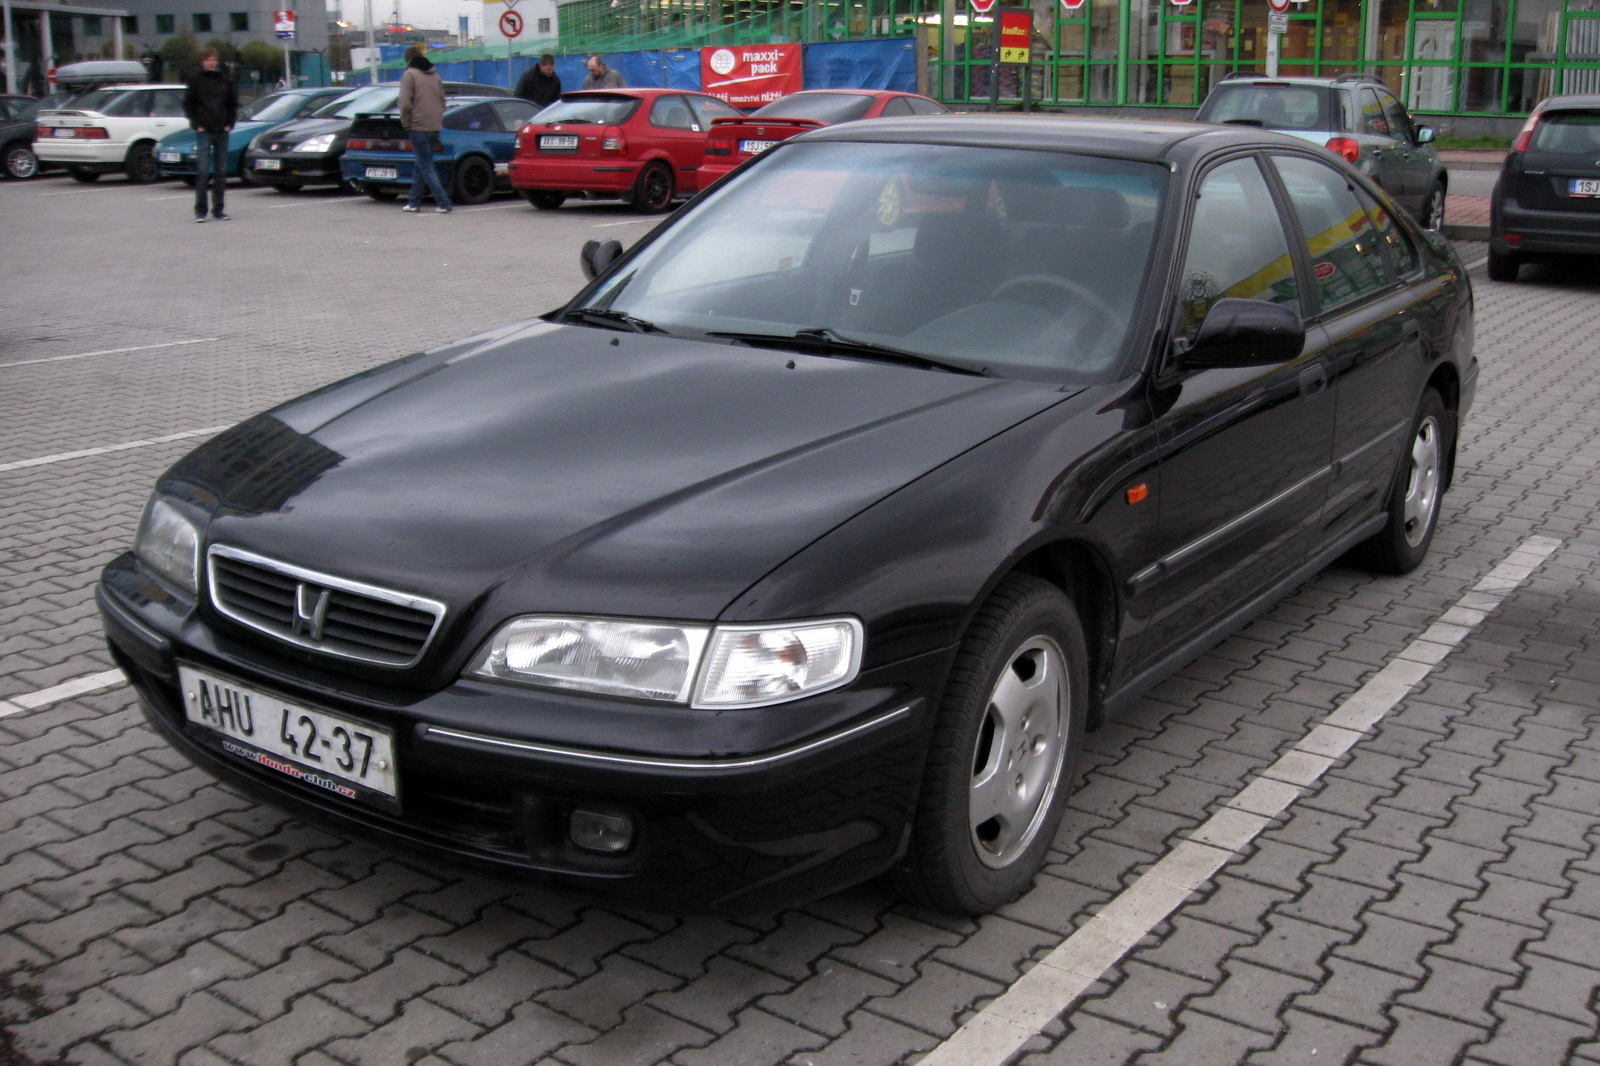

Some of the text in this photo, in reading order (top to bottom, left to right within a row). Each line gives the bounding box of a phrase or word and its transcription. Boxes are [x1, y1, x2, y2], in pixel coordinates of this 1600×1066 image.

[742, 49, 785, 62] maxxi-
[751, 61, 777, 76] pack
[746, 141, 760, 151] 1SJ
[1579, 181, 1599, 193] 1SJ
[198, 678, 373, 779] AHU 42-37
